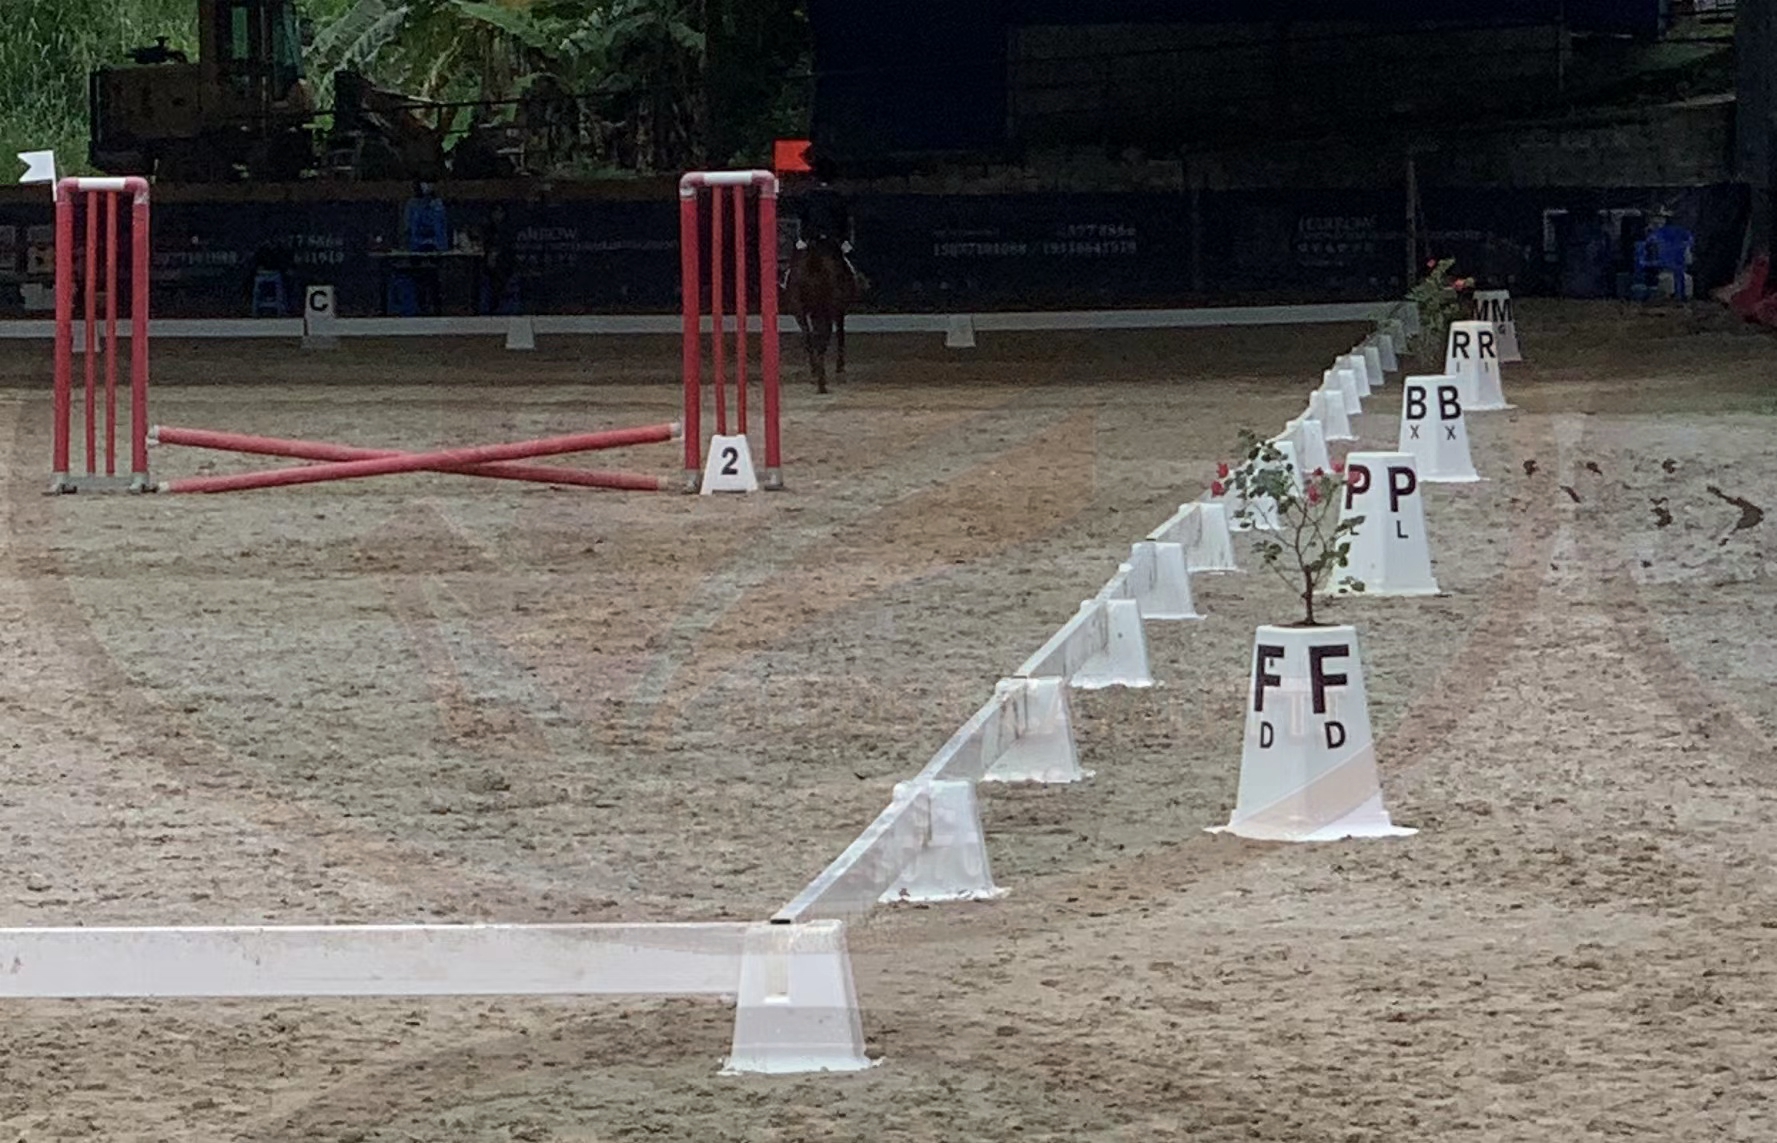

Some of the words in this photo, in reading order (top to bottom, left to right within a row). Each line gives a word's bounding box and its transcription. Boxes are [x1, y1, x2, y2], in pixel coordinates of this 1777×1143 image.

[310, 291, 328, 312] C
[1493, 299, 1512, 322] M
[1452, 331, 1470, 359] R
[1478, 331, 1496, 359] R
[1406, 386, 1427, 420] B
[1438, 386, 1462, 421] B
[721, 446, 739, 475] 2
[1345, 464, 1371, 509] P
[1388, 466, 1417, 512] P
[1396, 520, 1409, 539] L
[1254, 644, 1285, 712] F
[1309, 644, 1350, 714] F
[1260, 721, 1274, 748] D
[1325, 721, 1345, 750] D
